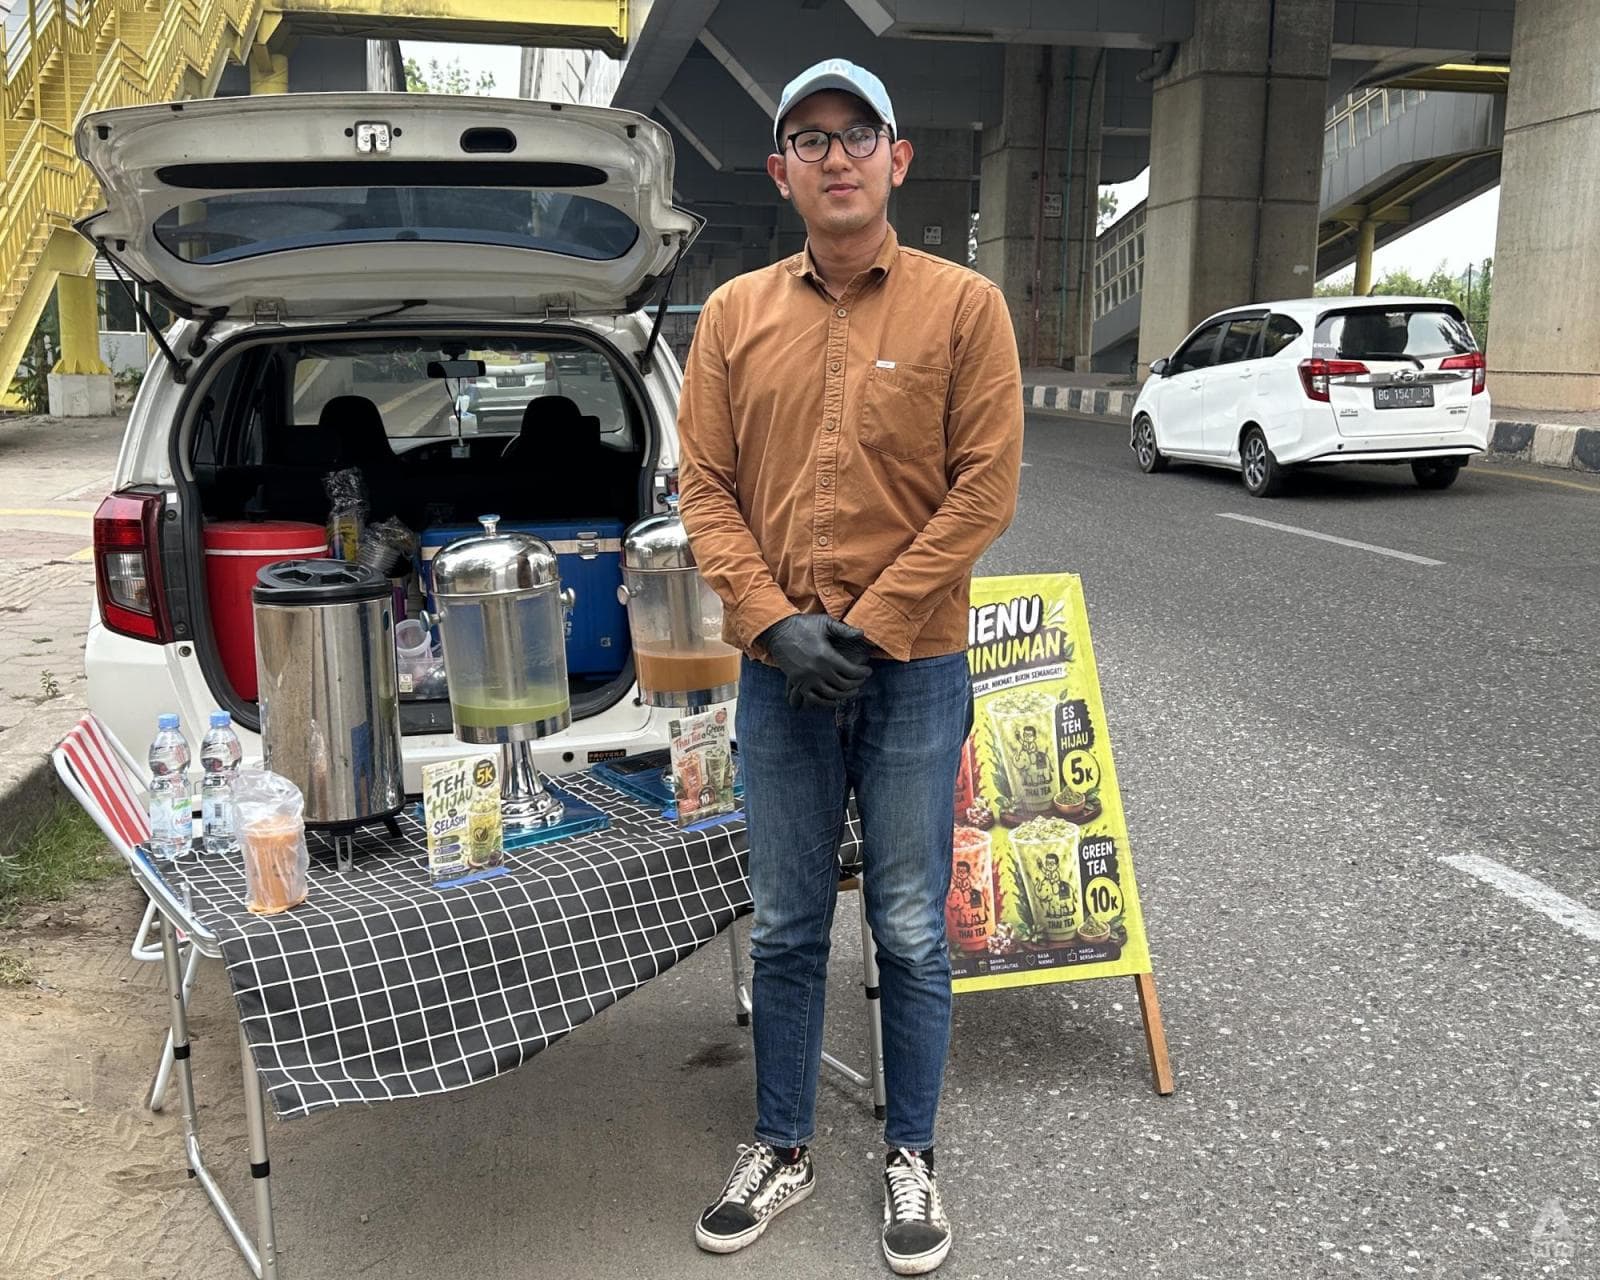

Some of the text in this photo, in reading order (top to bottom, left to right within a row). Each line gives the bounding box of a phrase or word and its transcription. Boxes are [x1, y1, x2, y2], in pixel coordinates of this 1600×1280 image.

[1378, 389, 1389, 400] BG
[1421, 387, 1431, 398] JR
[1062, 706, 1075, 720] ES
[1062, 718, 1082, 734] TEH
[1061, 733, 1089, 749] HIJAU
[476, 767, 494, 786] 5K
[1071, 756, 1094, 785] 5K
[432, 771, 466, 797] TEH
[432, 786, 473, 818] HIJAU
[433, 814, 467, 836] SELASIH
[1082, 841, 1113, 860] GREEN
[1087, 860, 1108, 876] TEA
[1090, 886, 1118, 913] 10K
[1049, 918, 1075, 929] THAI TEA
[958, 927, 987, 939] THAI TEA
